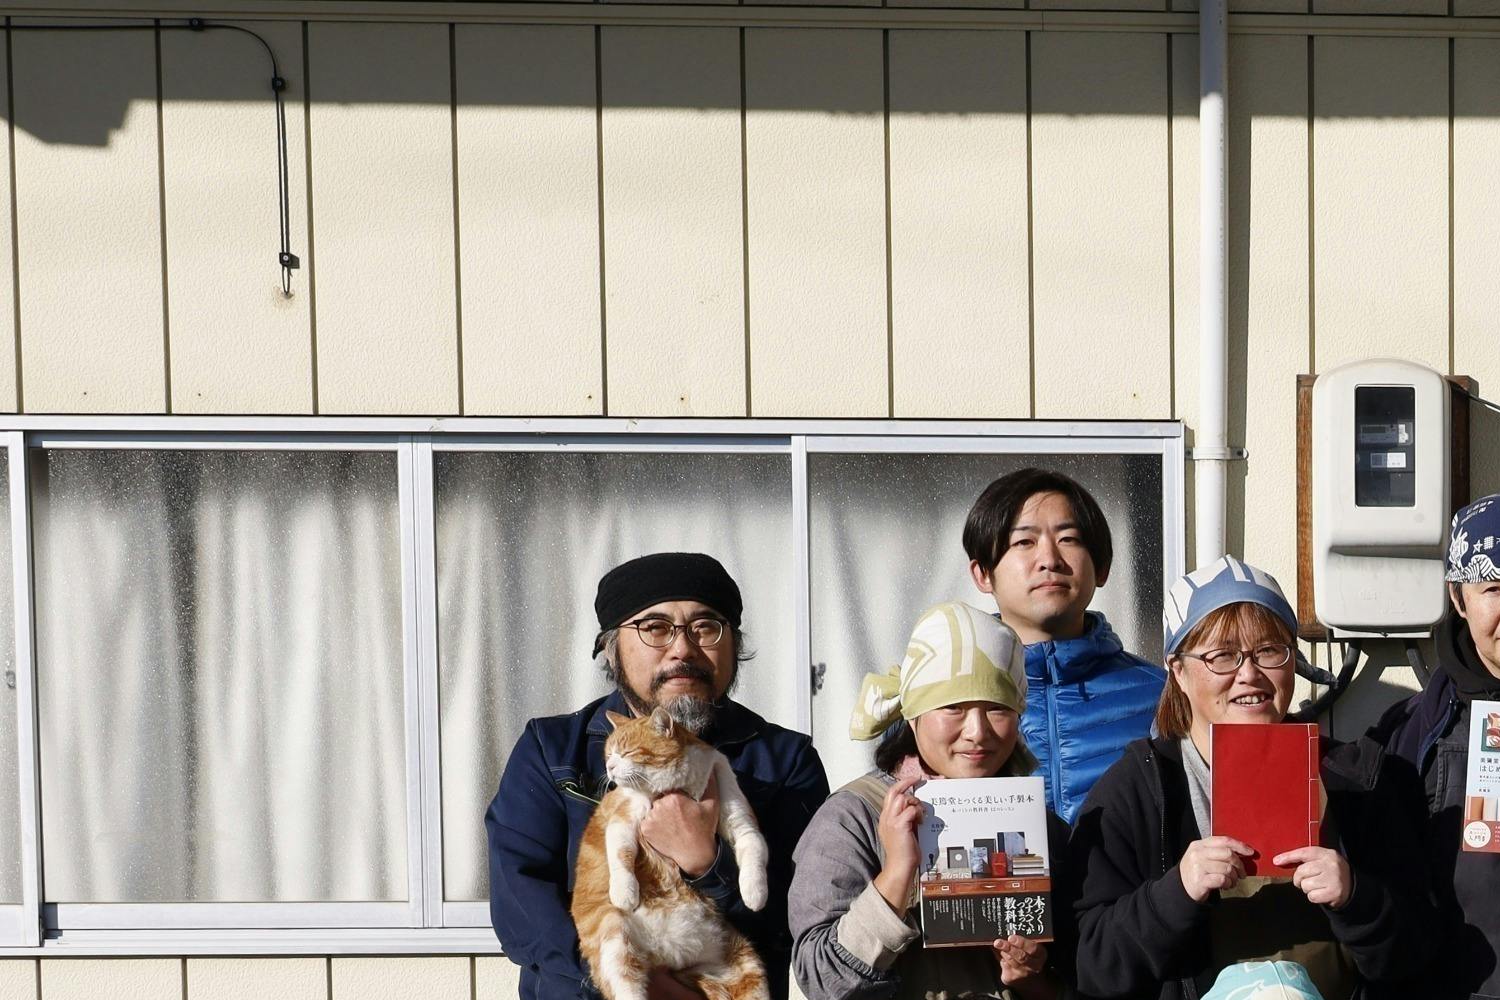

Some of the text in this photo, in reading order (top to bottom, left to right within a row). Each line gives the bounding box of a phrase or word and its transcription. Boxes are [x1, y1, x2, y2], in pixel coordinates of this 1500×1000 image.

[1016, 901, 1027, 931] つまった
[1024, 896, 1035, 935] のすべてが
[1033, 895, 1046, 935] 本づくり
